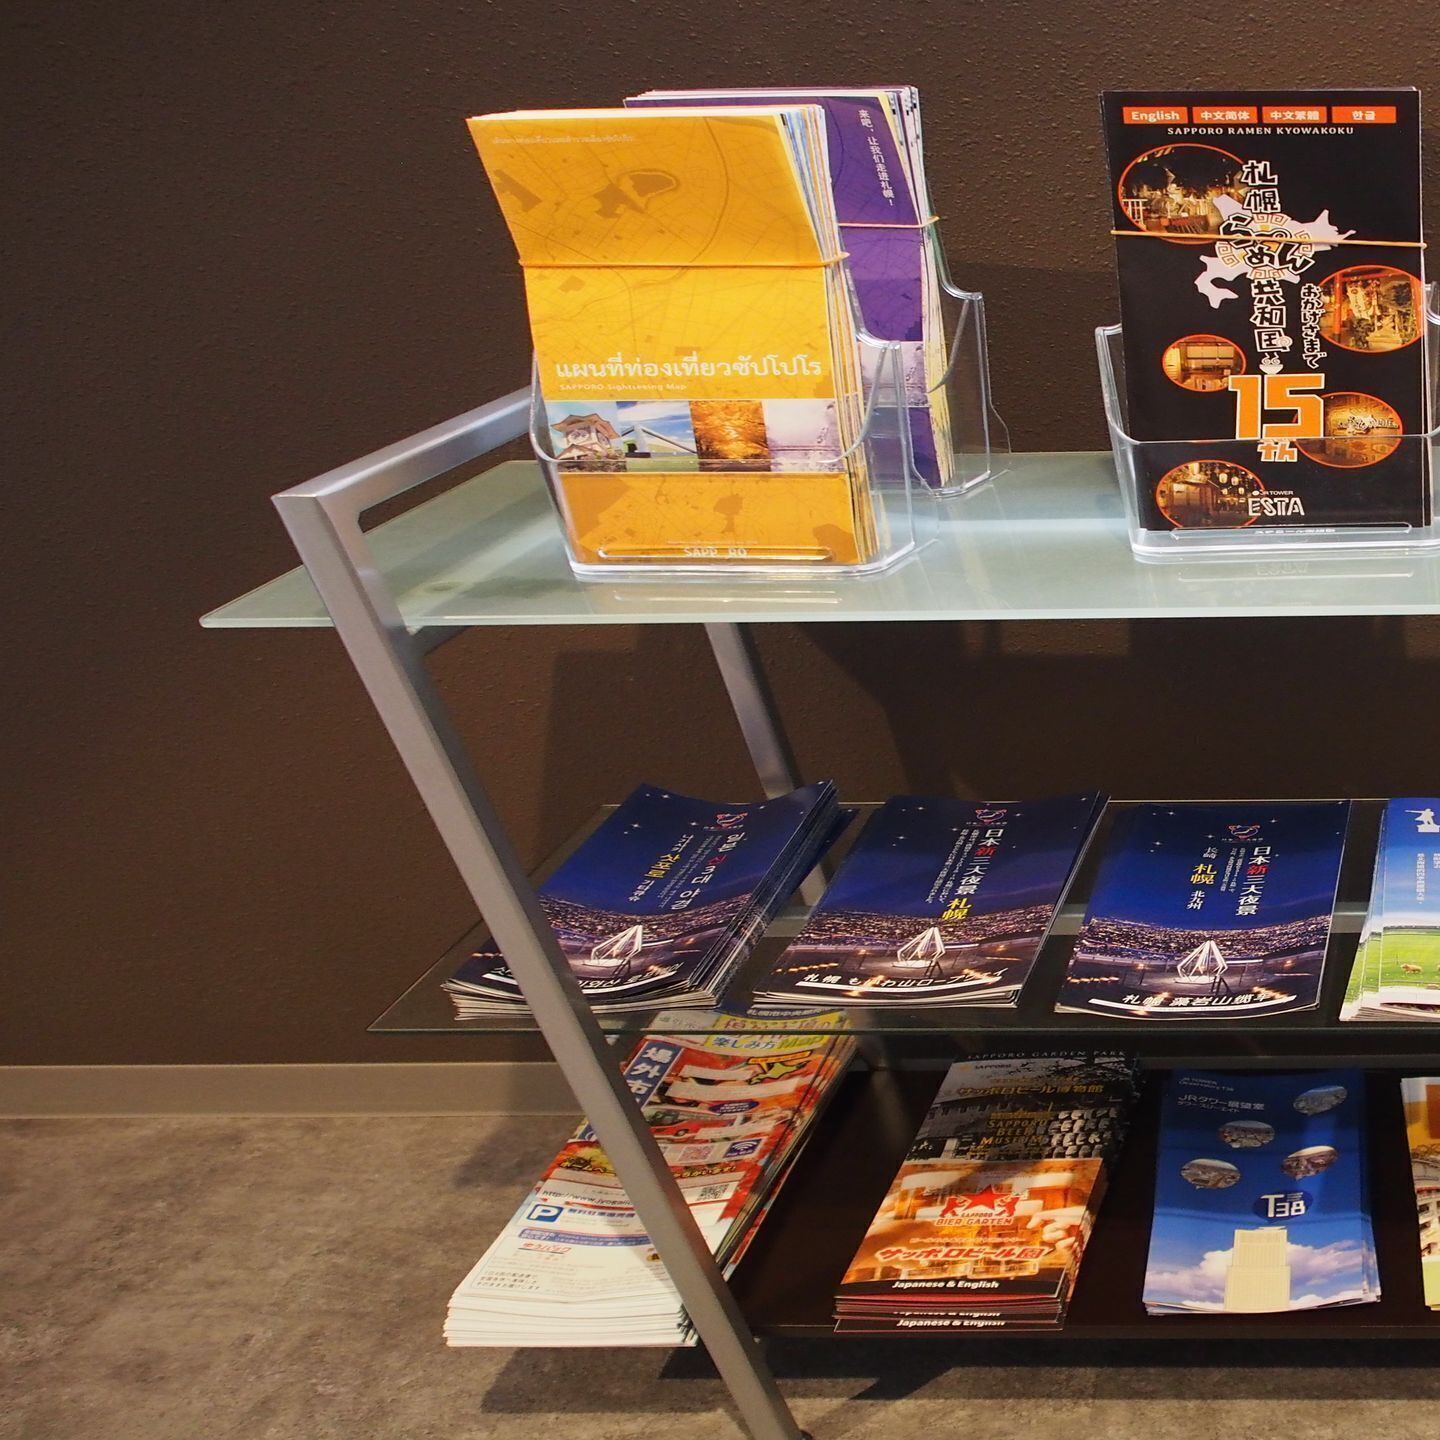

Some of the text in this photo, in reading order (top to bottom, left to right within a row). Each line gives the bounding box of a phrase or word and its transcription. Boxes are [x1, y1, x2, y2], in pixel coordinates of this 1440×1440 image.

[1131, 110, 1180, 122] English
[1200, 110, 1250, 121] 中文简体
[1351, 109, 1376, 121] 한글
[1167, 126, 1354, 135] SAPPORO RAMEN KYOWAKOKU
[1301, 283, 1327, 369] おかげさまで
[1228, 373, 1325, 440] 15
[1248, 497, 1305, 516] ESTA
[955, 828, 1004, 895] 日本新三大夜景
[803, 973, 842, 984] 札幌
[966, 1217, 1014, 1225] GARTEN
[879, 1247, 1046, 1260] サッポロビール園
[892, 1280, 1000, 1290] Japanese & English
